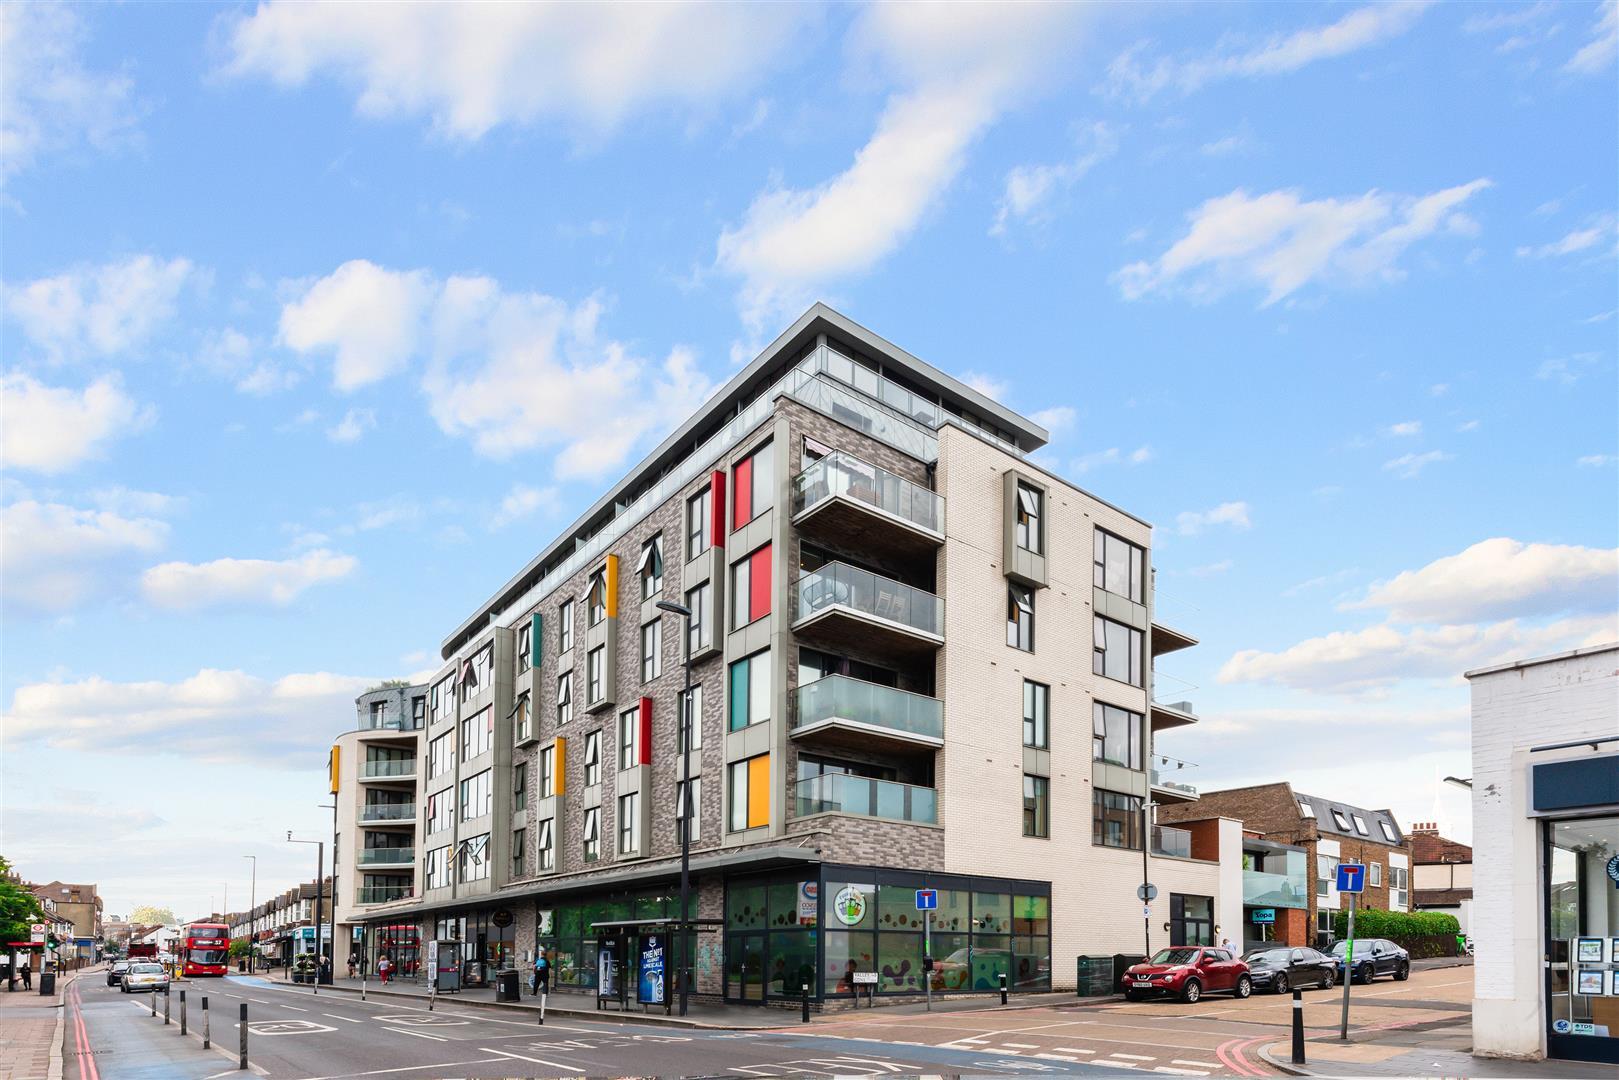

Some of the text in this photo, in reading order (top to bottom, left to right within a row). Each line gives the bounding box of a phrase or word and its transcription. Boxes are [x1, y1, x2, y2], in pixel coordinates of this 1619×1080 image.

[643, 950, 653, 960] THE
[643, 961, 663, 969] LIMESCALE
[251, 1023, 315, 1031] 20
